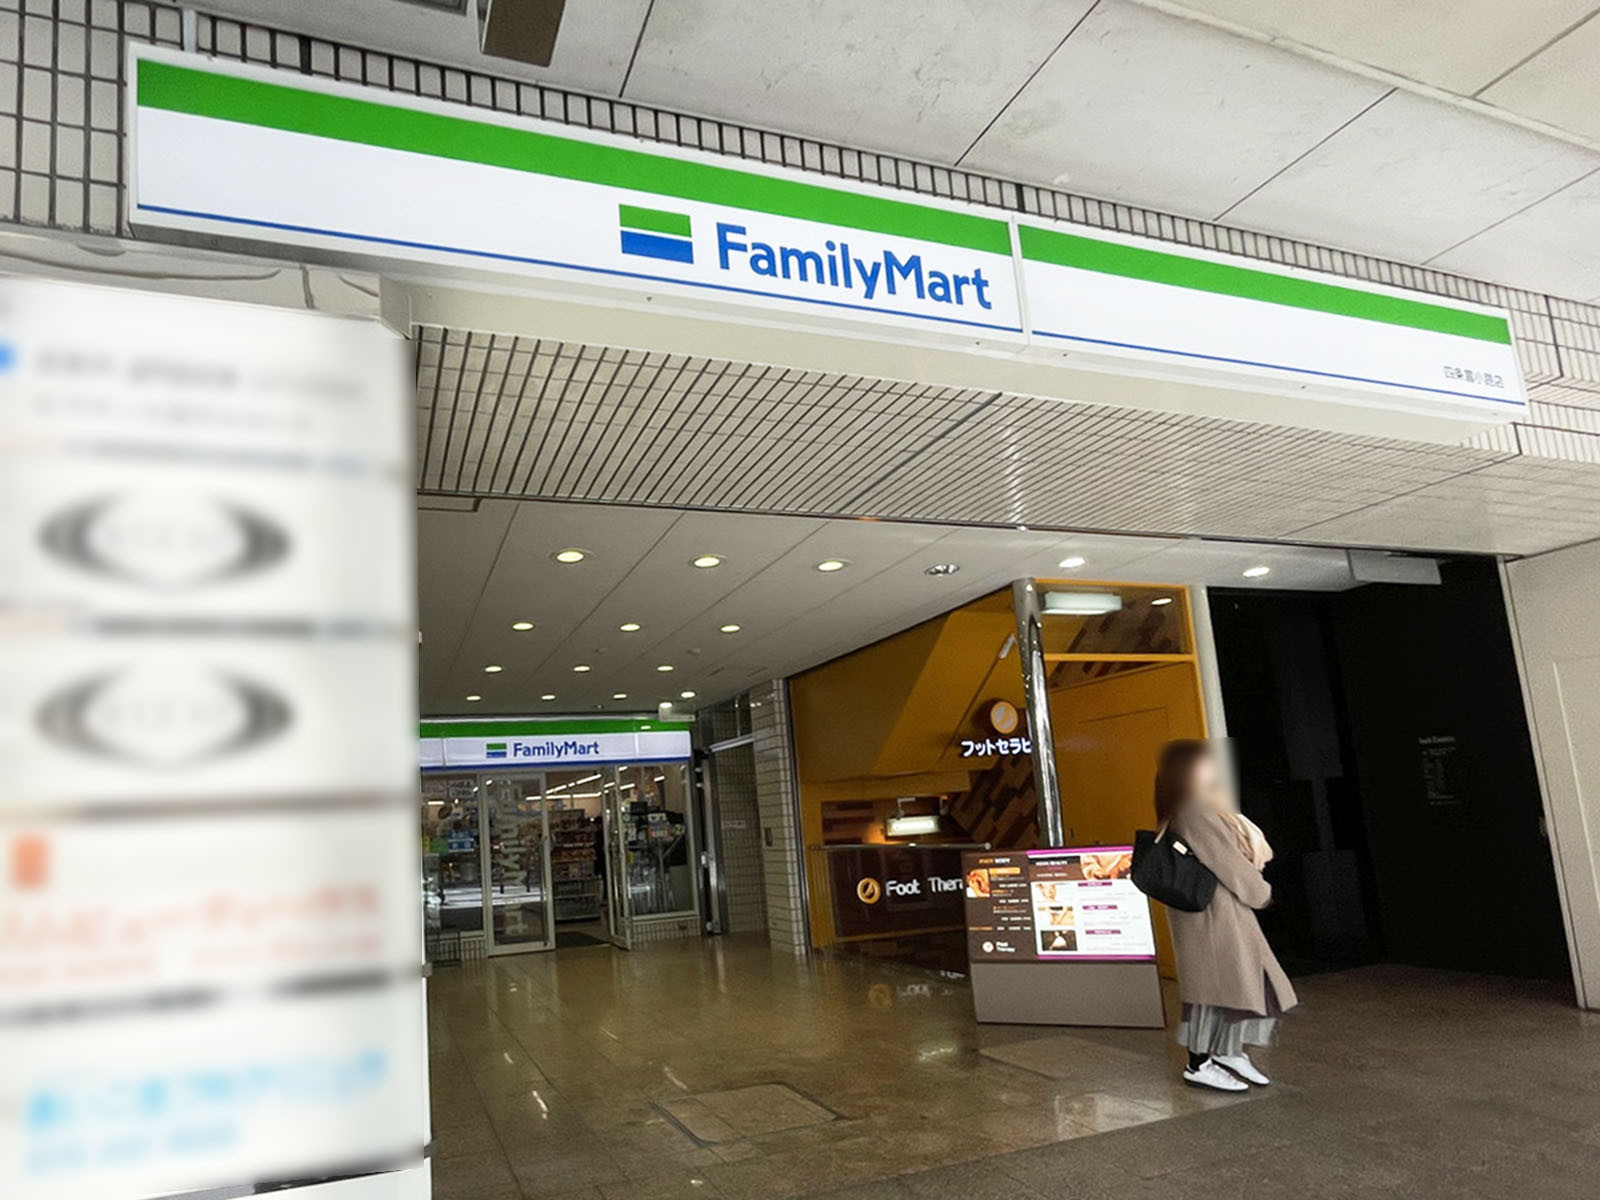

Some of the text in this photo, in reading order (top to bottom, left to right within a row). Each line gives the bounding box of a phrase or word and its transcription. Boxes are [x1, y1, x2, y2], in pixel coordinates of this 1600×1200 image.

[716, 221, 993, 310] FamilyMart
[512, 741, 600, 758] FamilyMart
[496, 783, 529, 936] FamilyMrt
[885, 876, 964, 897] Foot Ther
